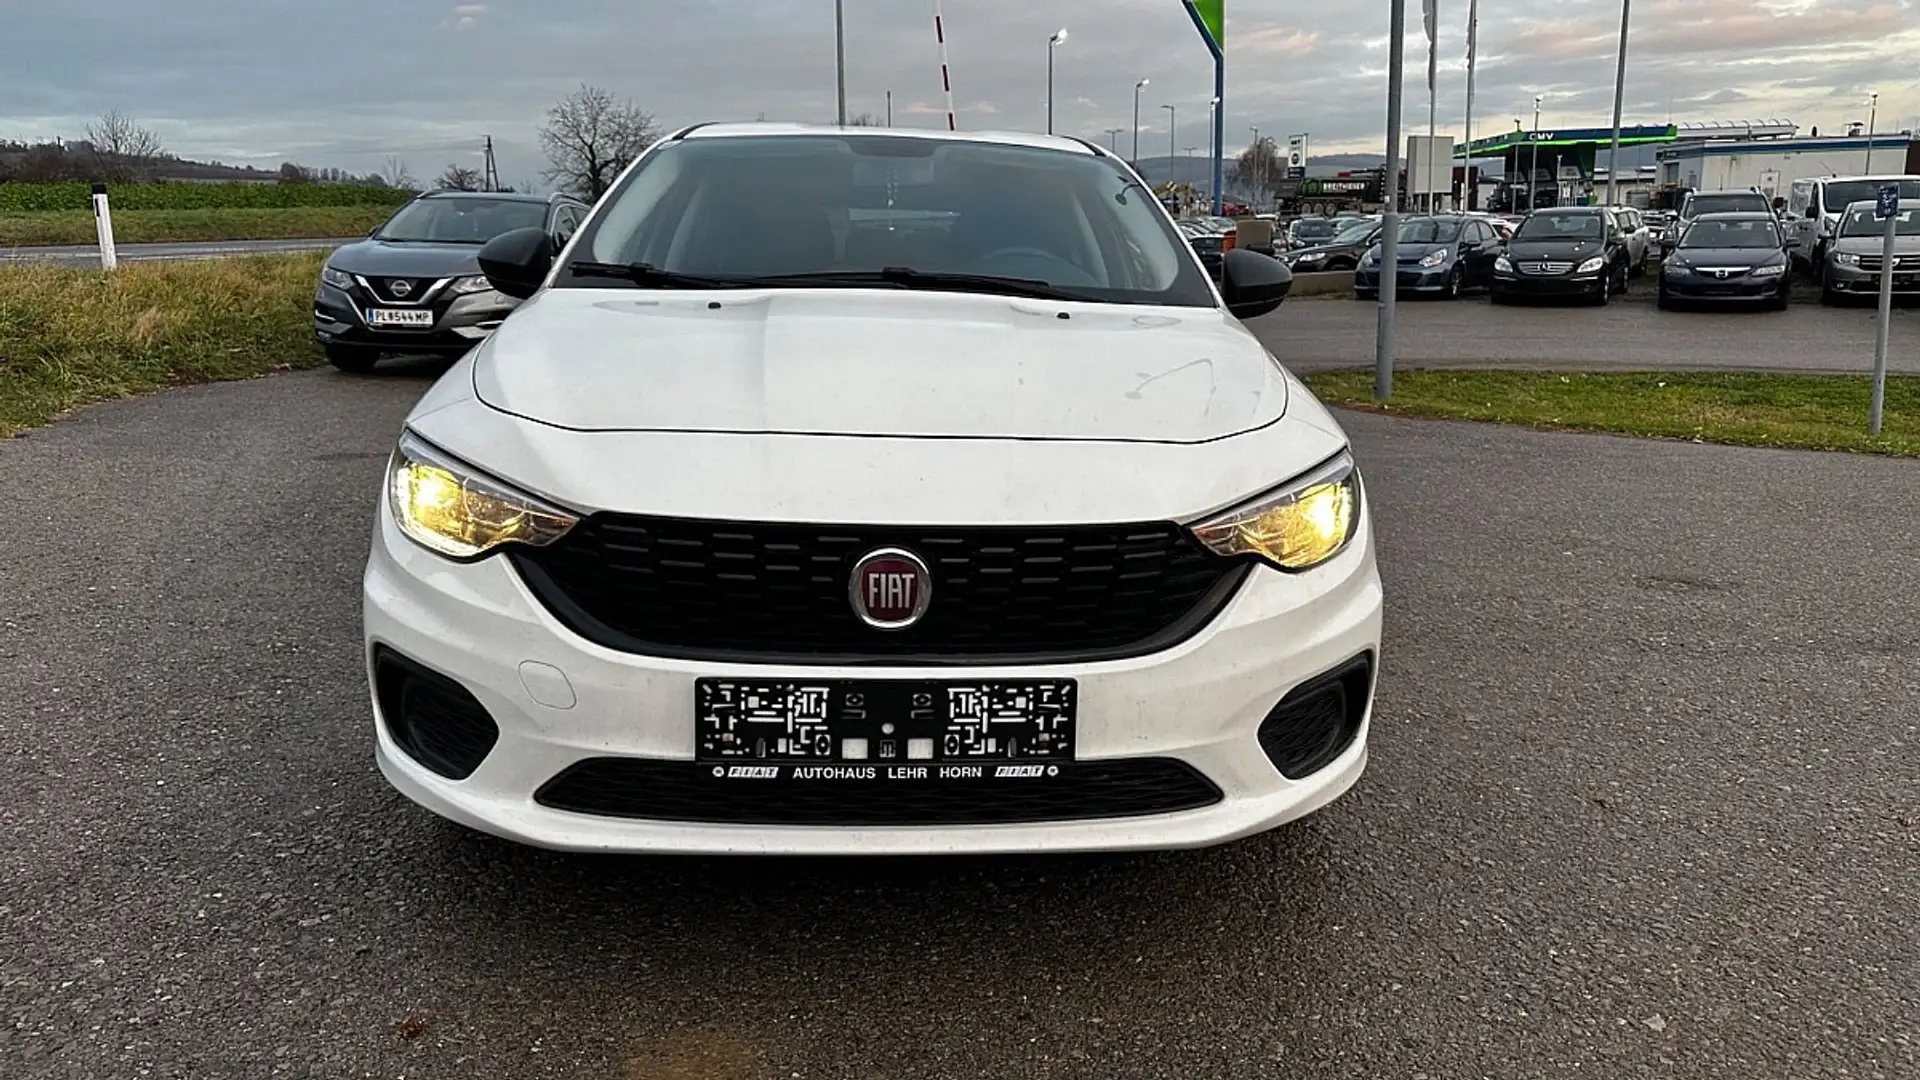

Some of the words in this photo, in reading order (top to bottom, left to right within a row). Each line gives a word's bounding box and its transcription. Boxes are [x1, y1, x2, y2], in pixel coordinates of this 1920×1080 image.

[868, 572, 915, 609] FIAT
[727, 766, 779, 779] FIAT
[792, 766, 876, 779] AUTOHAUS
[887, 767, 928, 779] LEHR
[939, 766, 983, 779] HORN
[994, 765, 1045, 778] FIAT
